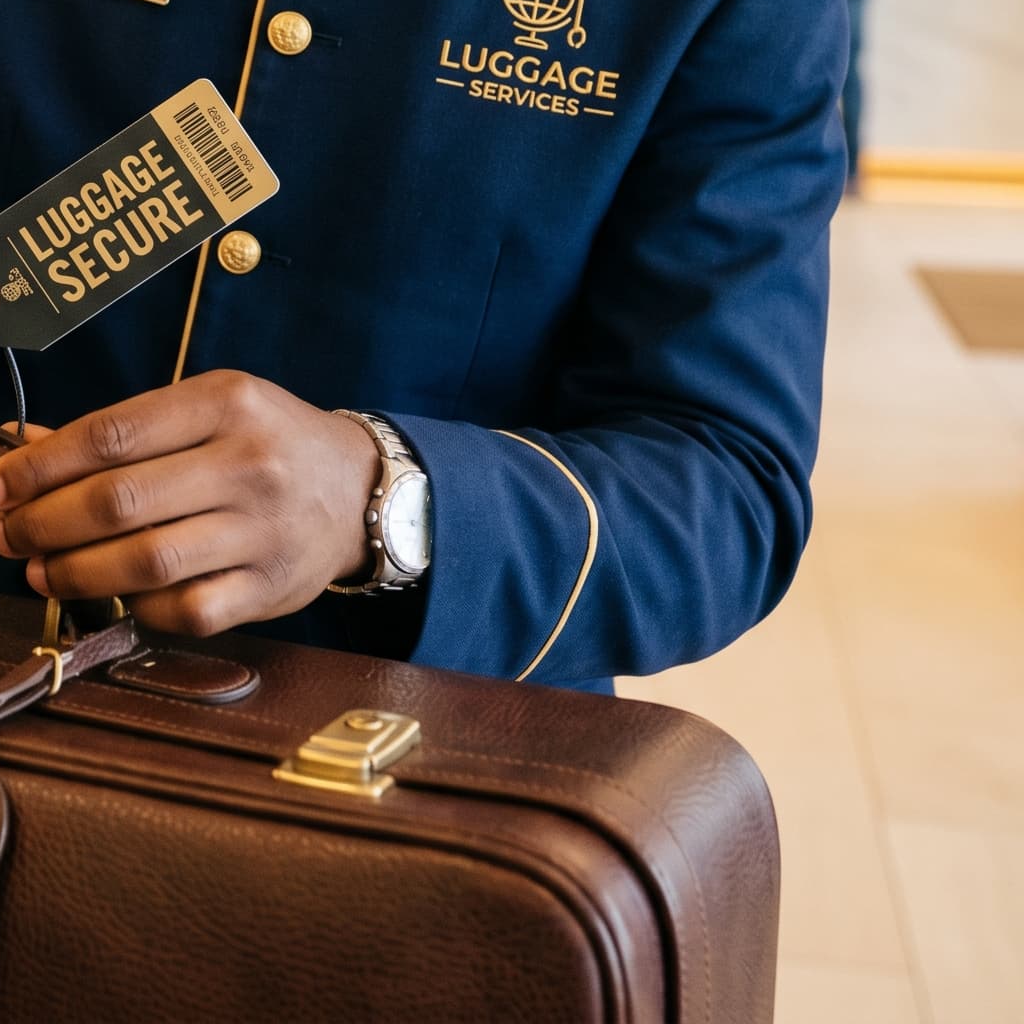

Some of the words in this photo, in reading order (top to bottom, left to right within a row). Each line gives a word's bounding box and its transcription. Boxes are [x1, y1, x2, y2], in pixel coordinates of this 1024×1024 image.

[439, 39, 620, 99] LUGGAGE
[468, 79, 580, 116] SERVICES
[18, 139, 175, 263] LUGGAGE
[47, 179, 204, 303] SECURE
